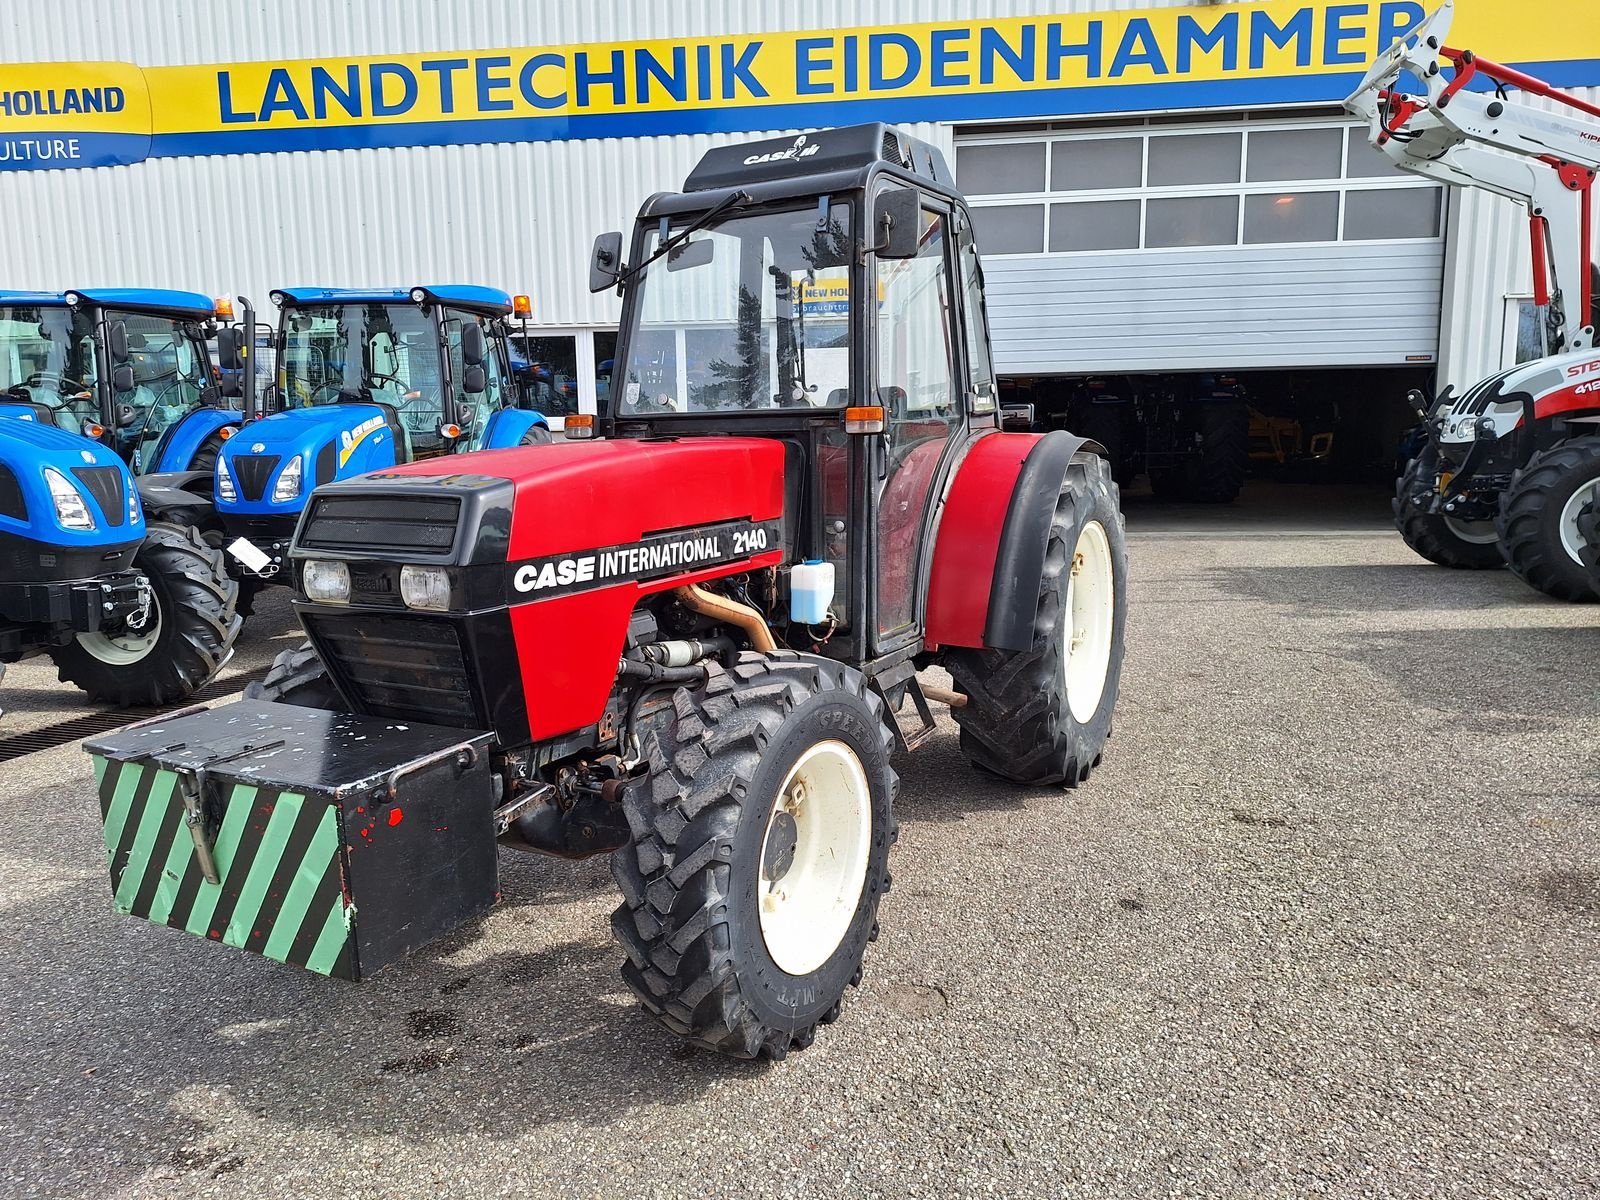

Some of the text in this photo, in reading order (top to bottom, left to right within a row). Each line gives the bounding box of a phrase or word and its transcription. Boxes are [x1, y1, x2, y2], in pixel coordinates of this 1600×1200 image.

[217, 1, 1426, 124] LANDTECHNIK EIDENHAMMER
[0, 139, 80, 160] ULTURE
[805, 288, 828, 298] NEW
[513, 528, 767, 593] CASE INTERNATIONAL 2140
